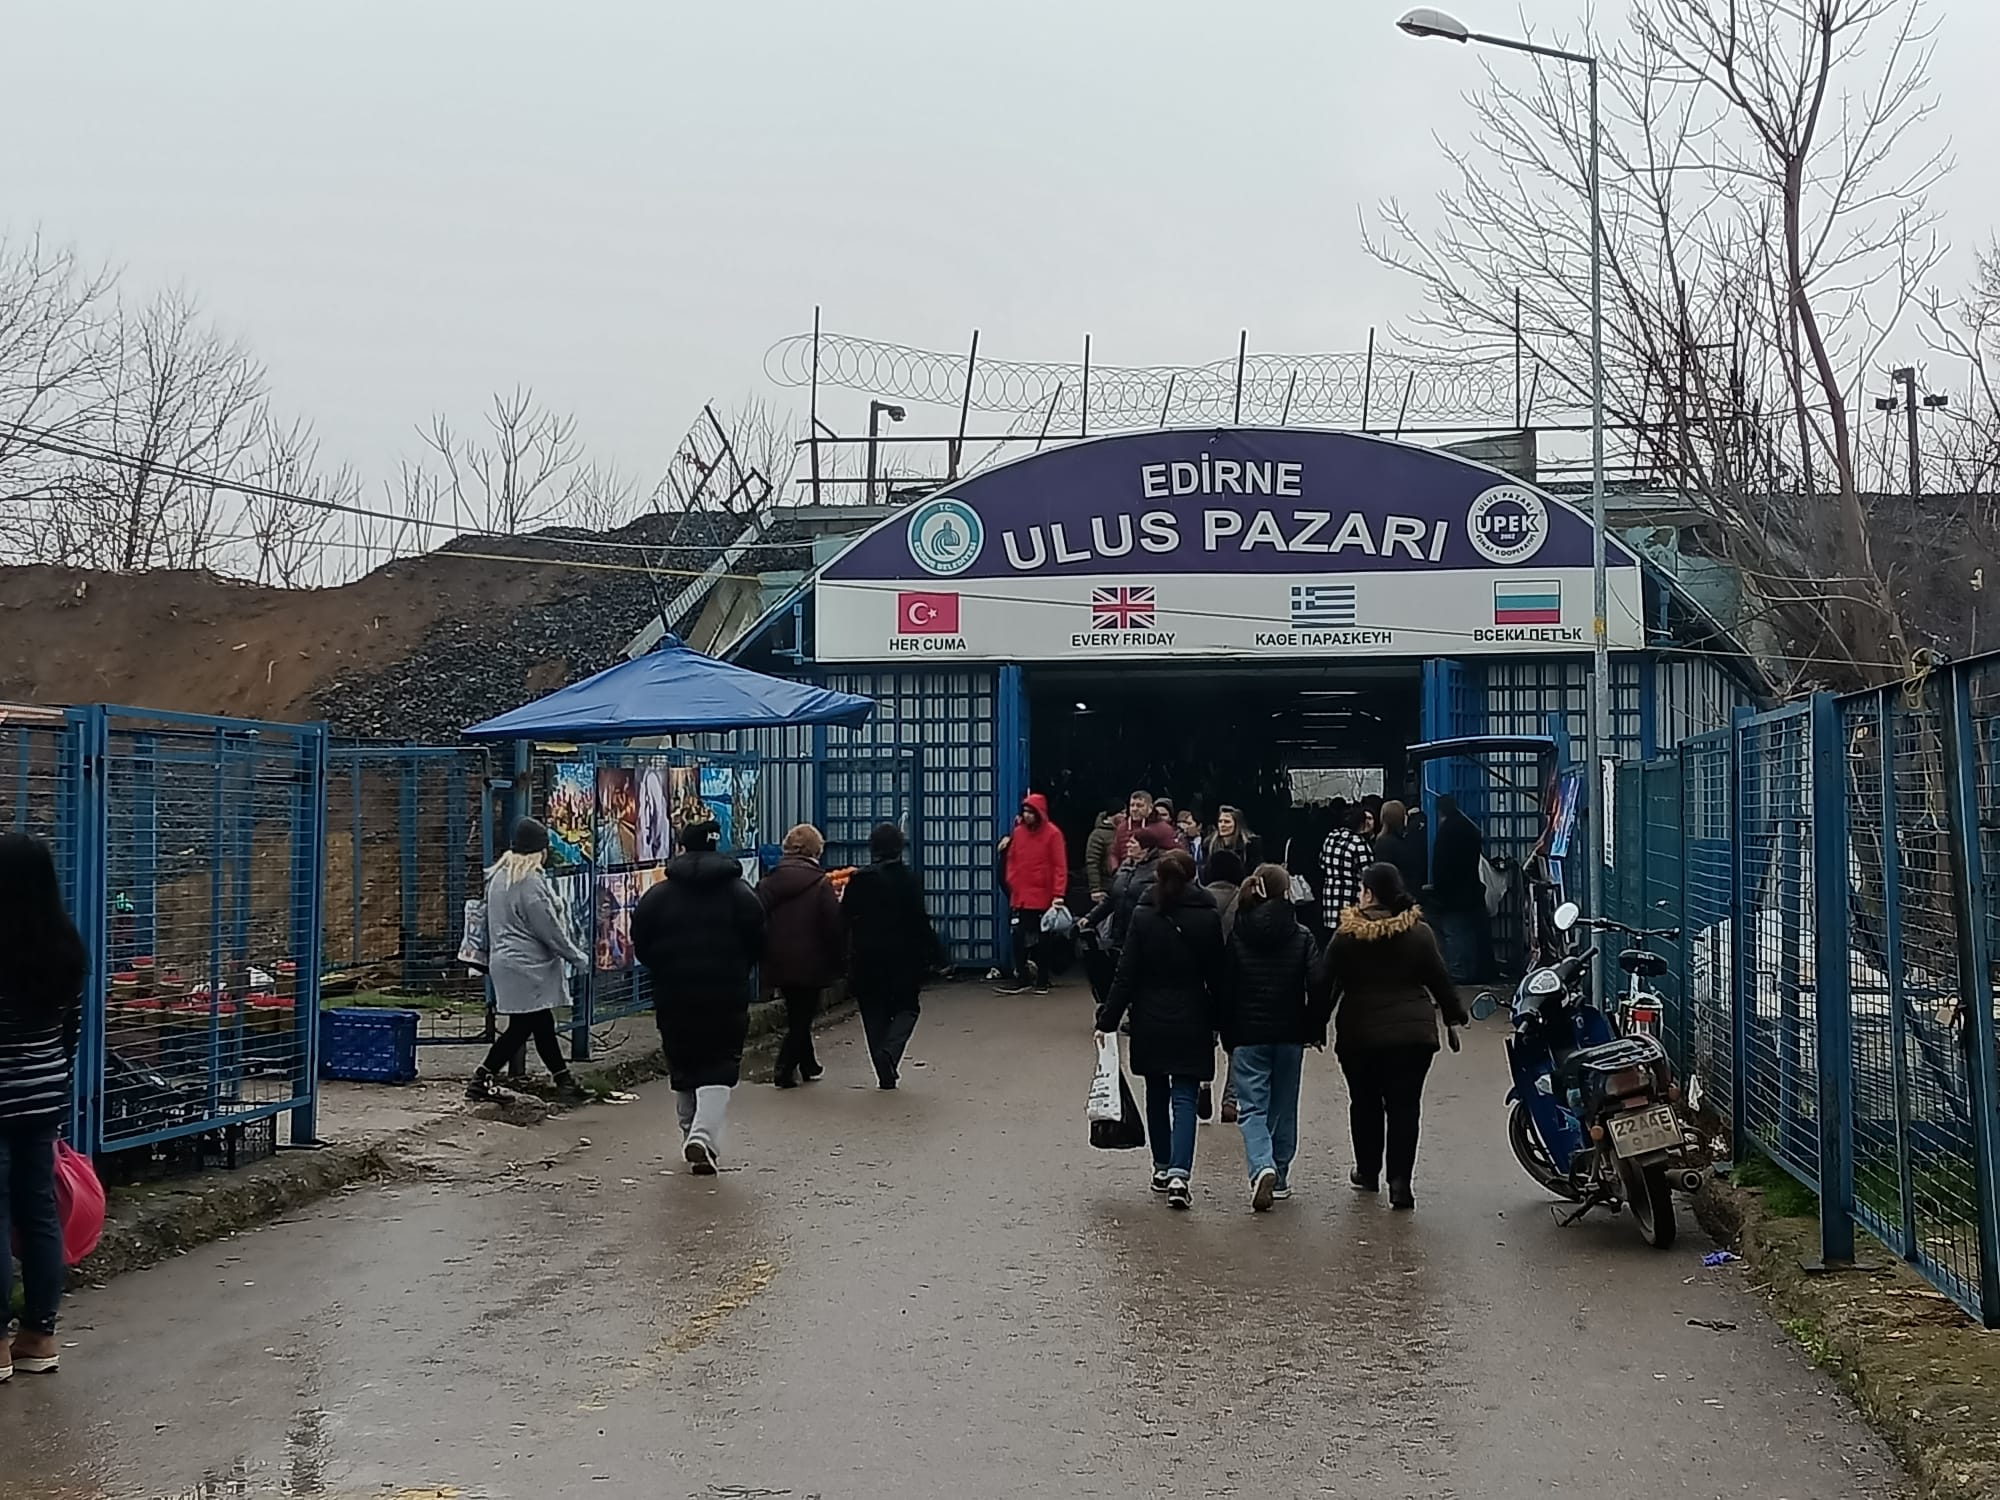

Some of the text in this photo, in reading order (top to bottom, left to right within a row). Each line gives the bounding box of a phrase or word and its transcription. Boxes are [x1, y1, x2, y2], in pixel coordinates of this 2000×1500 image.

[1142, 453, 1302, 498] EDİRNE
[1478, 493, 1534, 512] ULUS PAZARI
[1475, 513, 1540, 533] UPEK
[1003, 511, 1449, 570] ULUS PAZARI
[889, 638, 967, 651] HER CUMA
[1072, 633, 1175, 647] EVERY FRIDAY
[1255, 632, 1392, 646] ΚΑΘΕ ΠΑΡΑΣΚΕΥΗ
[1473, 629, 1525, 642] ВСЕКИ
[1614, 1119, 1638, 1137] 22
